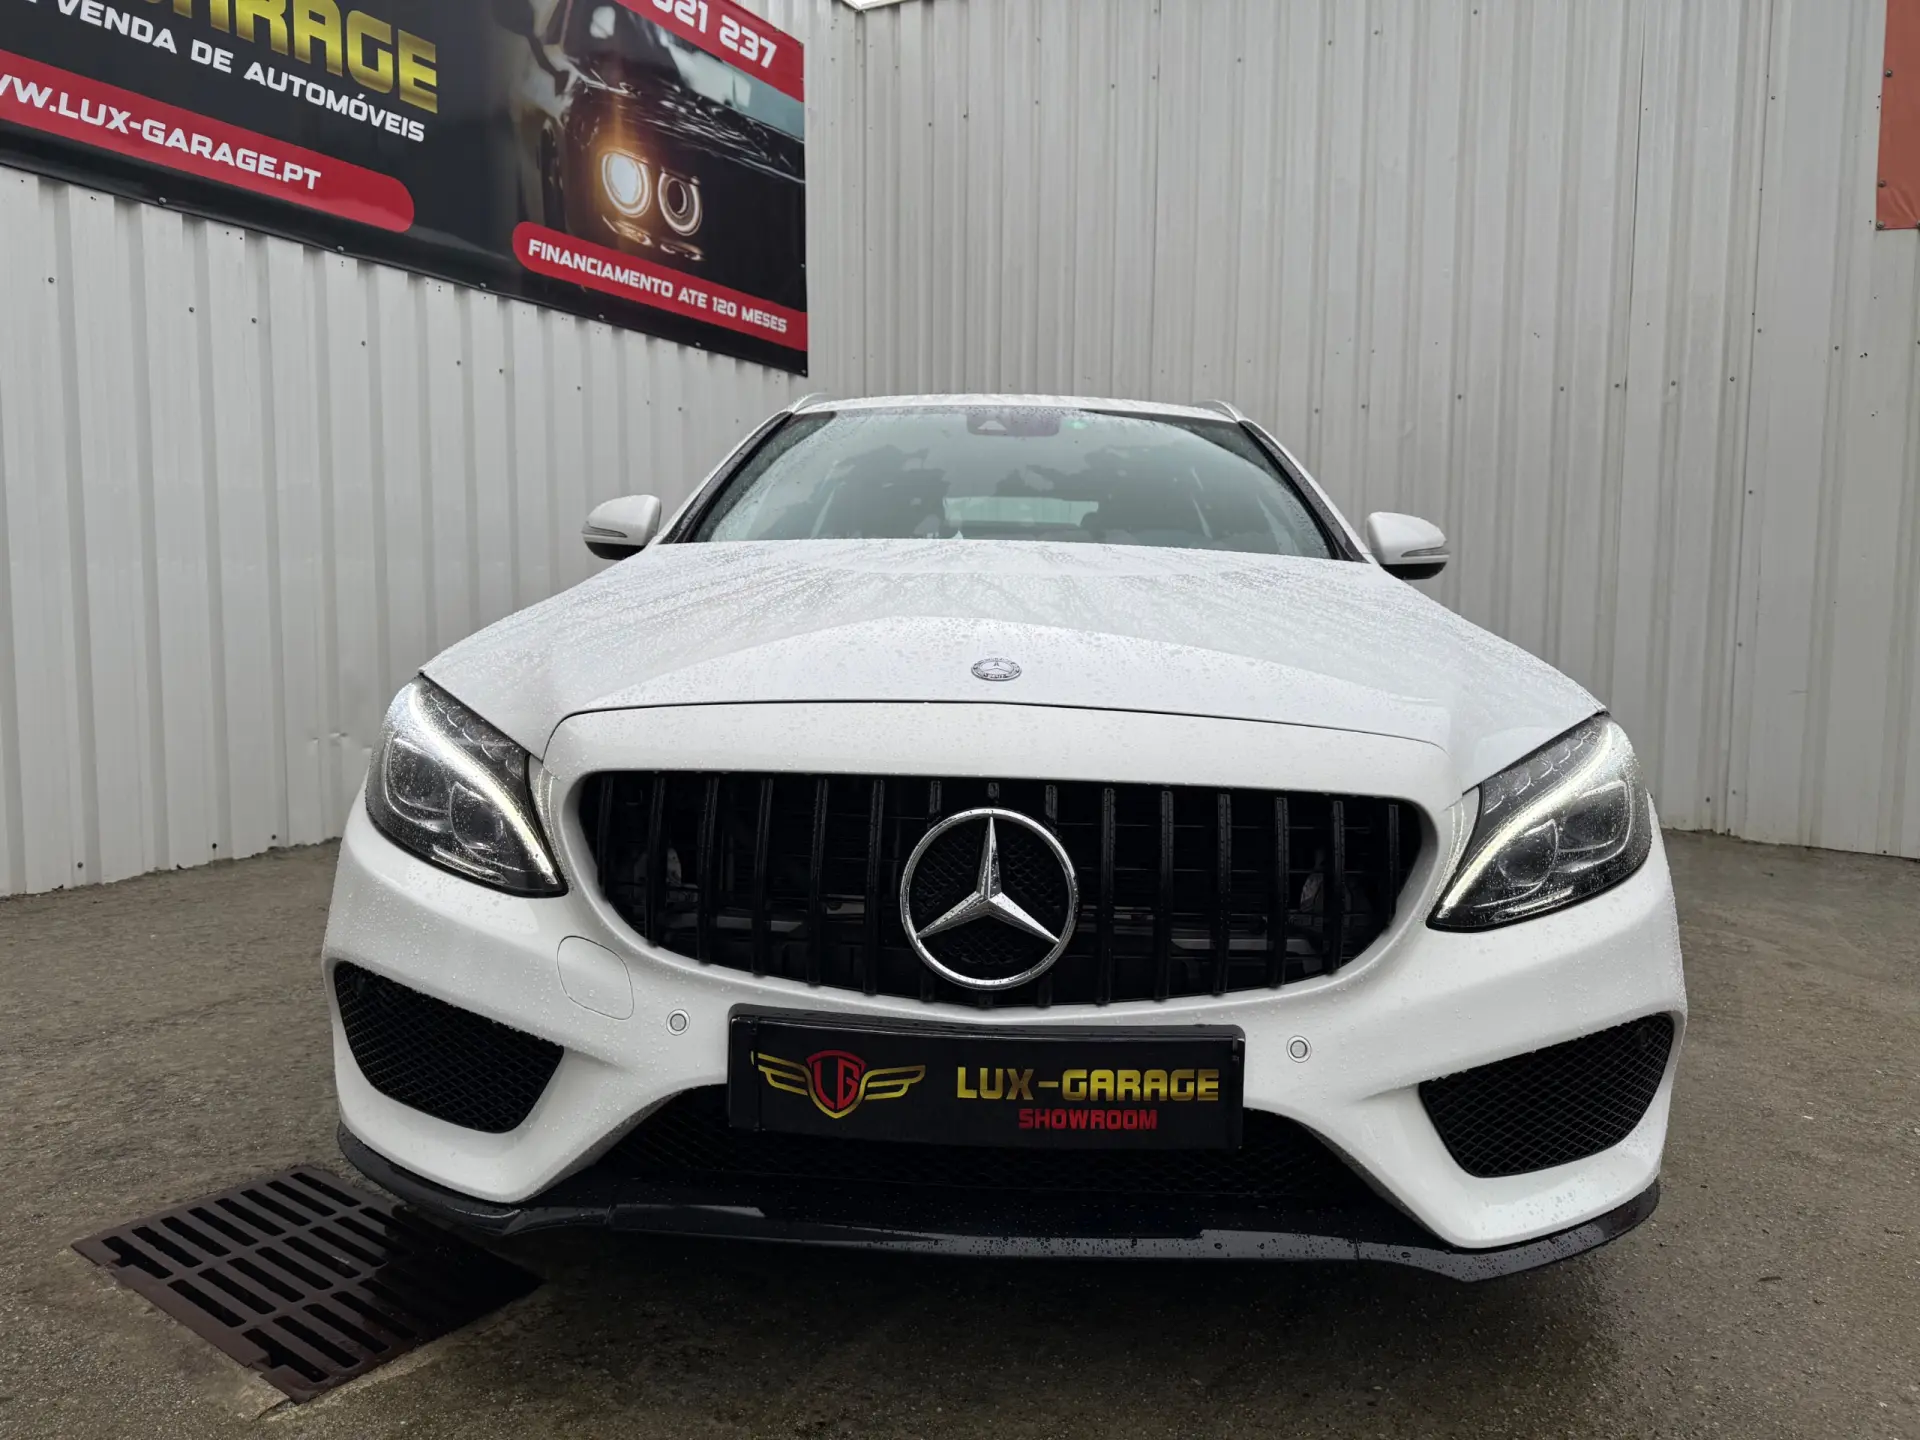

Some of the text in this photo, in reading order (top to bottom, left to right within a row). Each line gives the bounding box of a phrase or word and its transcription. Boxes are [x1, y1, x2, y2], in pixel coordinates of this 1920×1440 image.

[719, 14, 777, 69] 237
[57, 0, 425, 142] VENDA DE AUTOMÓVEIS
[528, 239, 788, 333] FINANCIAMENTO ATE 120 MESES
[956, 1066, 1219, 1101] LUX-GARAGE
[1018, 1108, 1158, 1131] SHOWROOM
